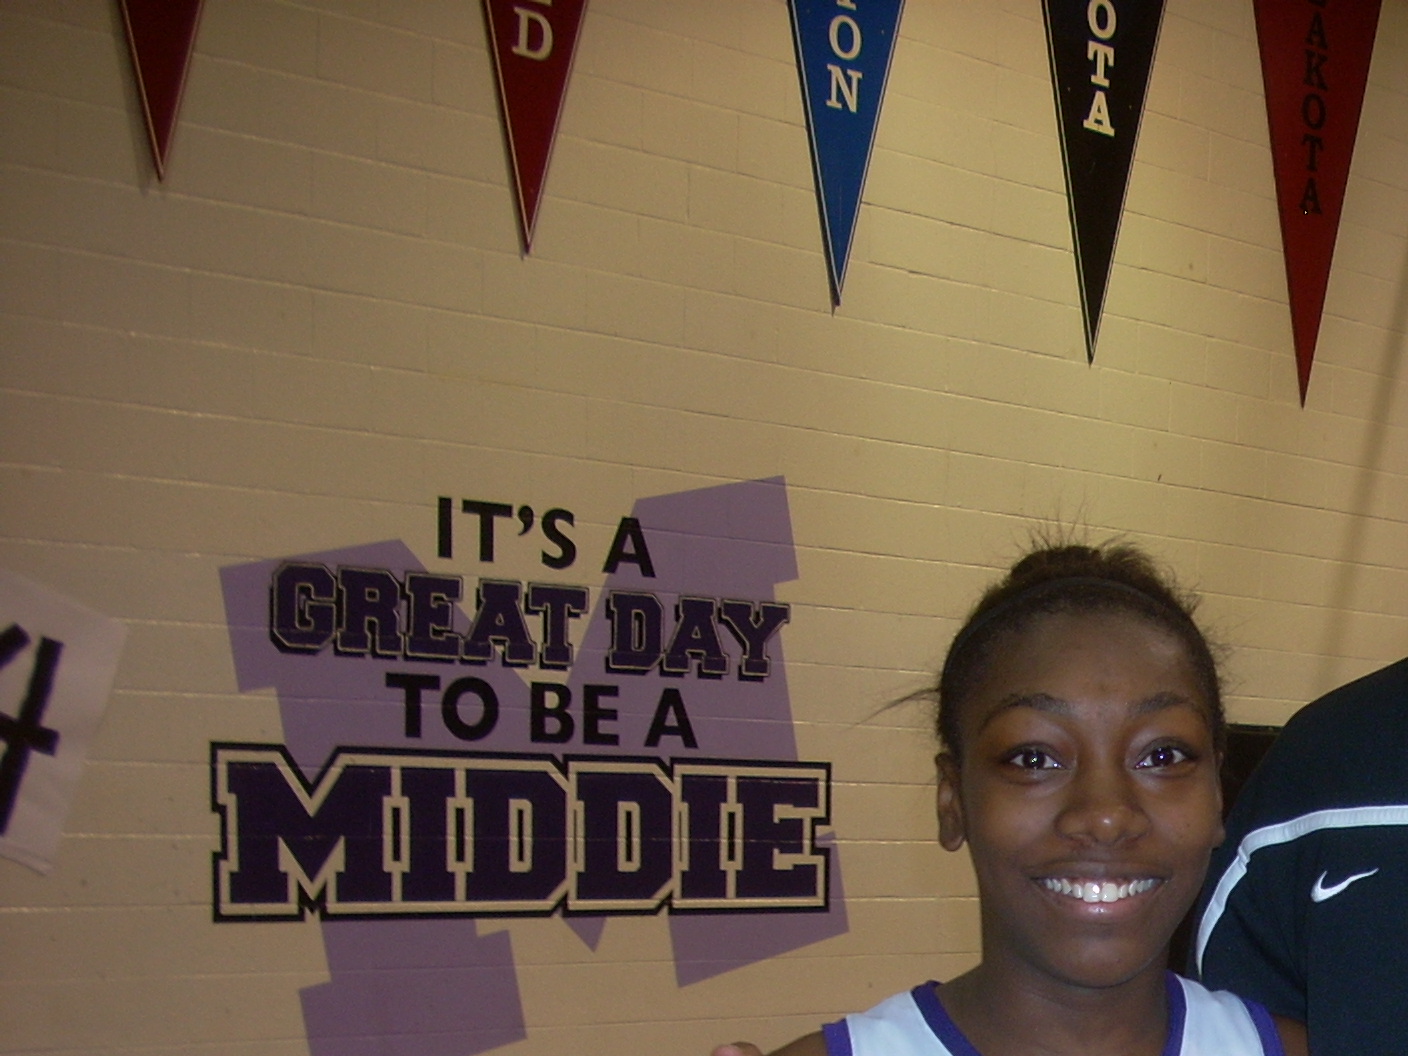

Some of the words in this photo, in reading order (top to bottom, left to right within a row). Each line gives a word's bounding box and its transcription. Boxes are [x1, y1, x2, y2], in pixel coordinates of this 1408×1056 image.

[825, 0, 863, 114] ON
[1299, 0, 1329, 215] AKOTA
[437, 496, 577, 570] IT'S
[603, 516, 657, 579] A
[270, 562, 591, 669] GREAT
[606, 589, 792, 682] DAY
[385, 672, 501, 742] TO
[530, 682, 619, 746] BE
[644, 688, 700, 750] A
[210, 741, 832, 922] MIDDIE
